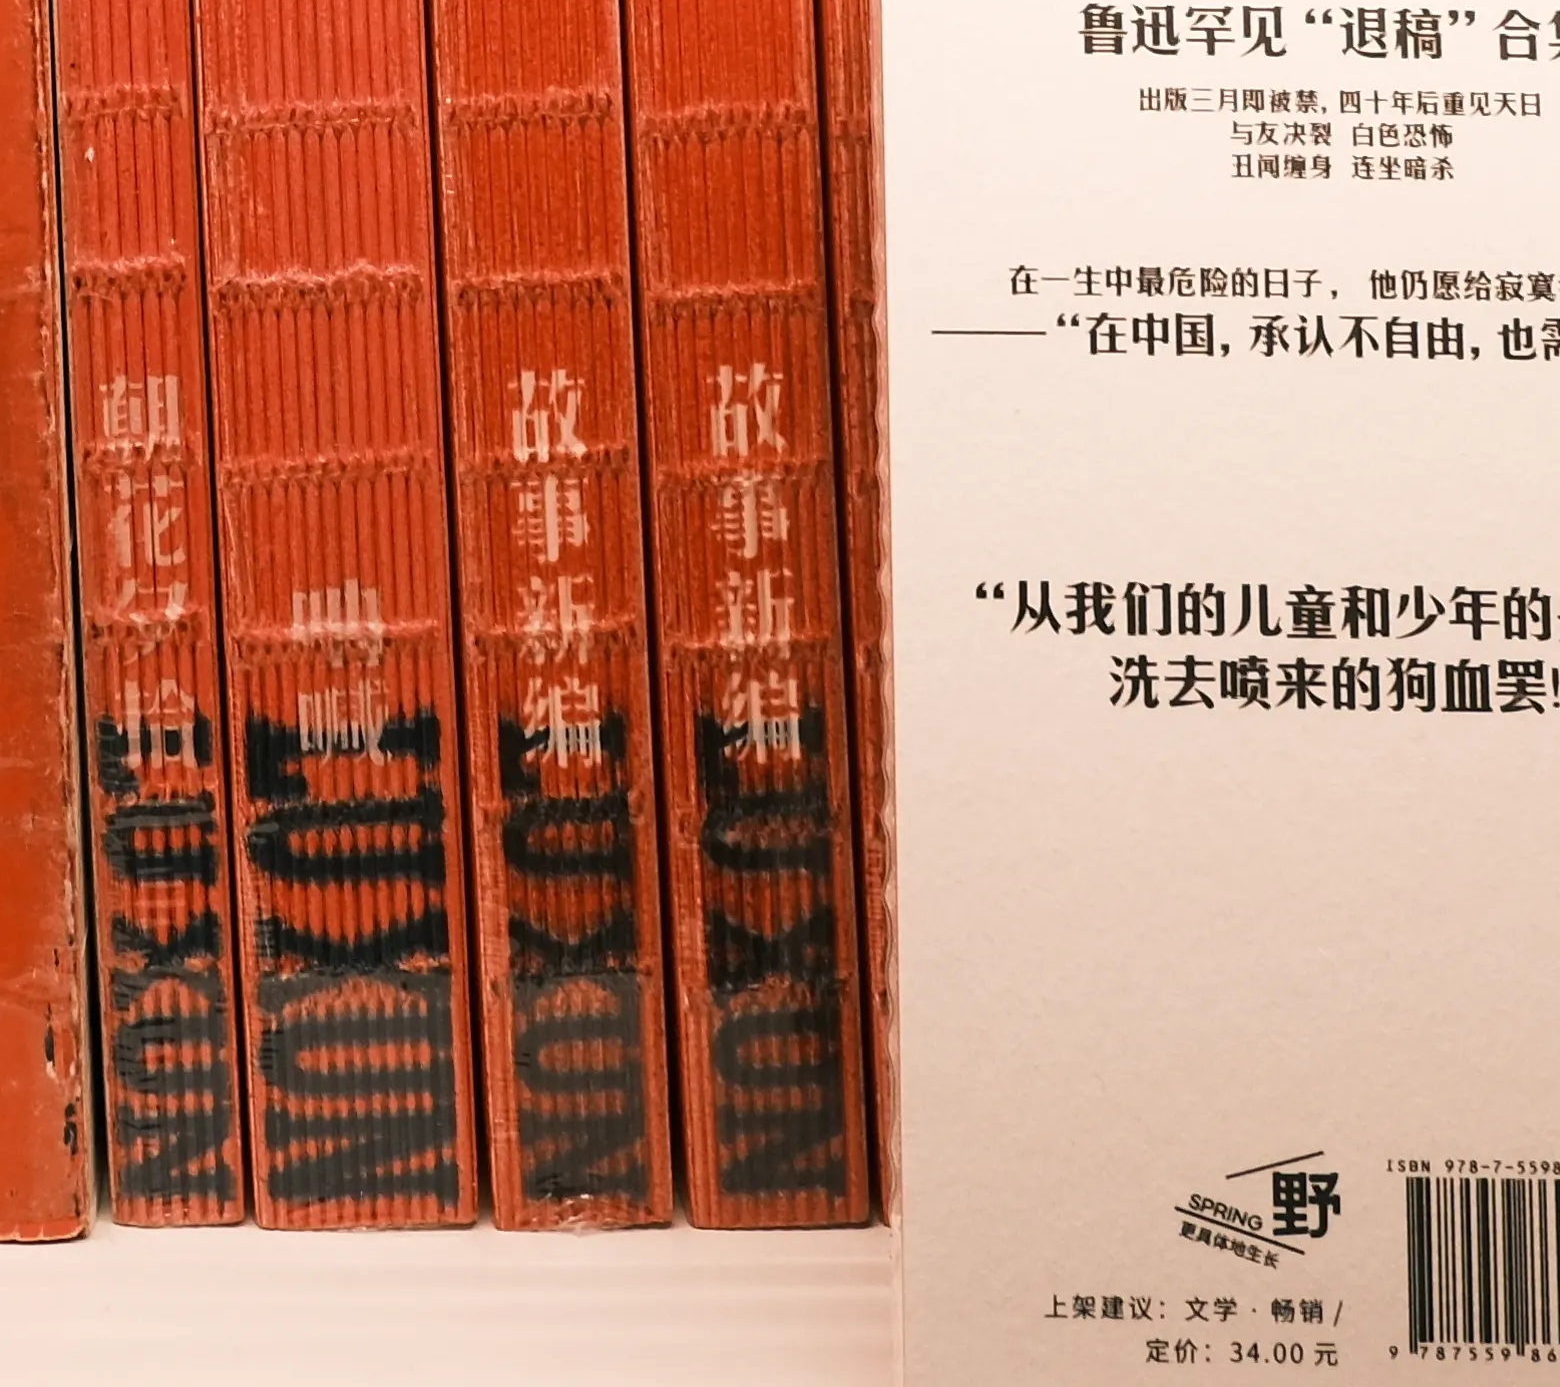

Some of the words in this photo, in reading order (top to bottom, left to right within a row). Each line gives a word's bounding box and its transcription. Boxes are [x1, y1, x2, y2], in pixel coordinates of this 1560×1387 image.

[1230, 121, 1333, 148] 与友决裂
[1351, 122, 1454, 149] 白色恐怖
[1230, 153, 1333, 180] 丑闻缠身
[1351, 154, 1456, 181] 连坐暗杀
[509, 366, 604, 769] 故事新编
[706, 361, 804, 767] 故事新编
[1385, 1158, 1432, 1174] ISBN
[1187, 1193, 1265, 1232] SPRING
[1271, 1169, 1342, 1239] 野
